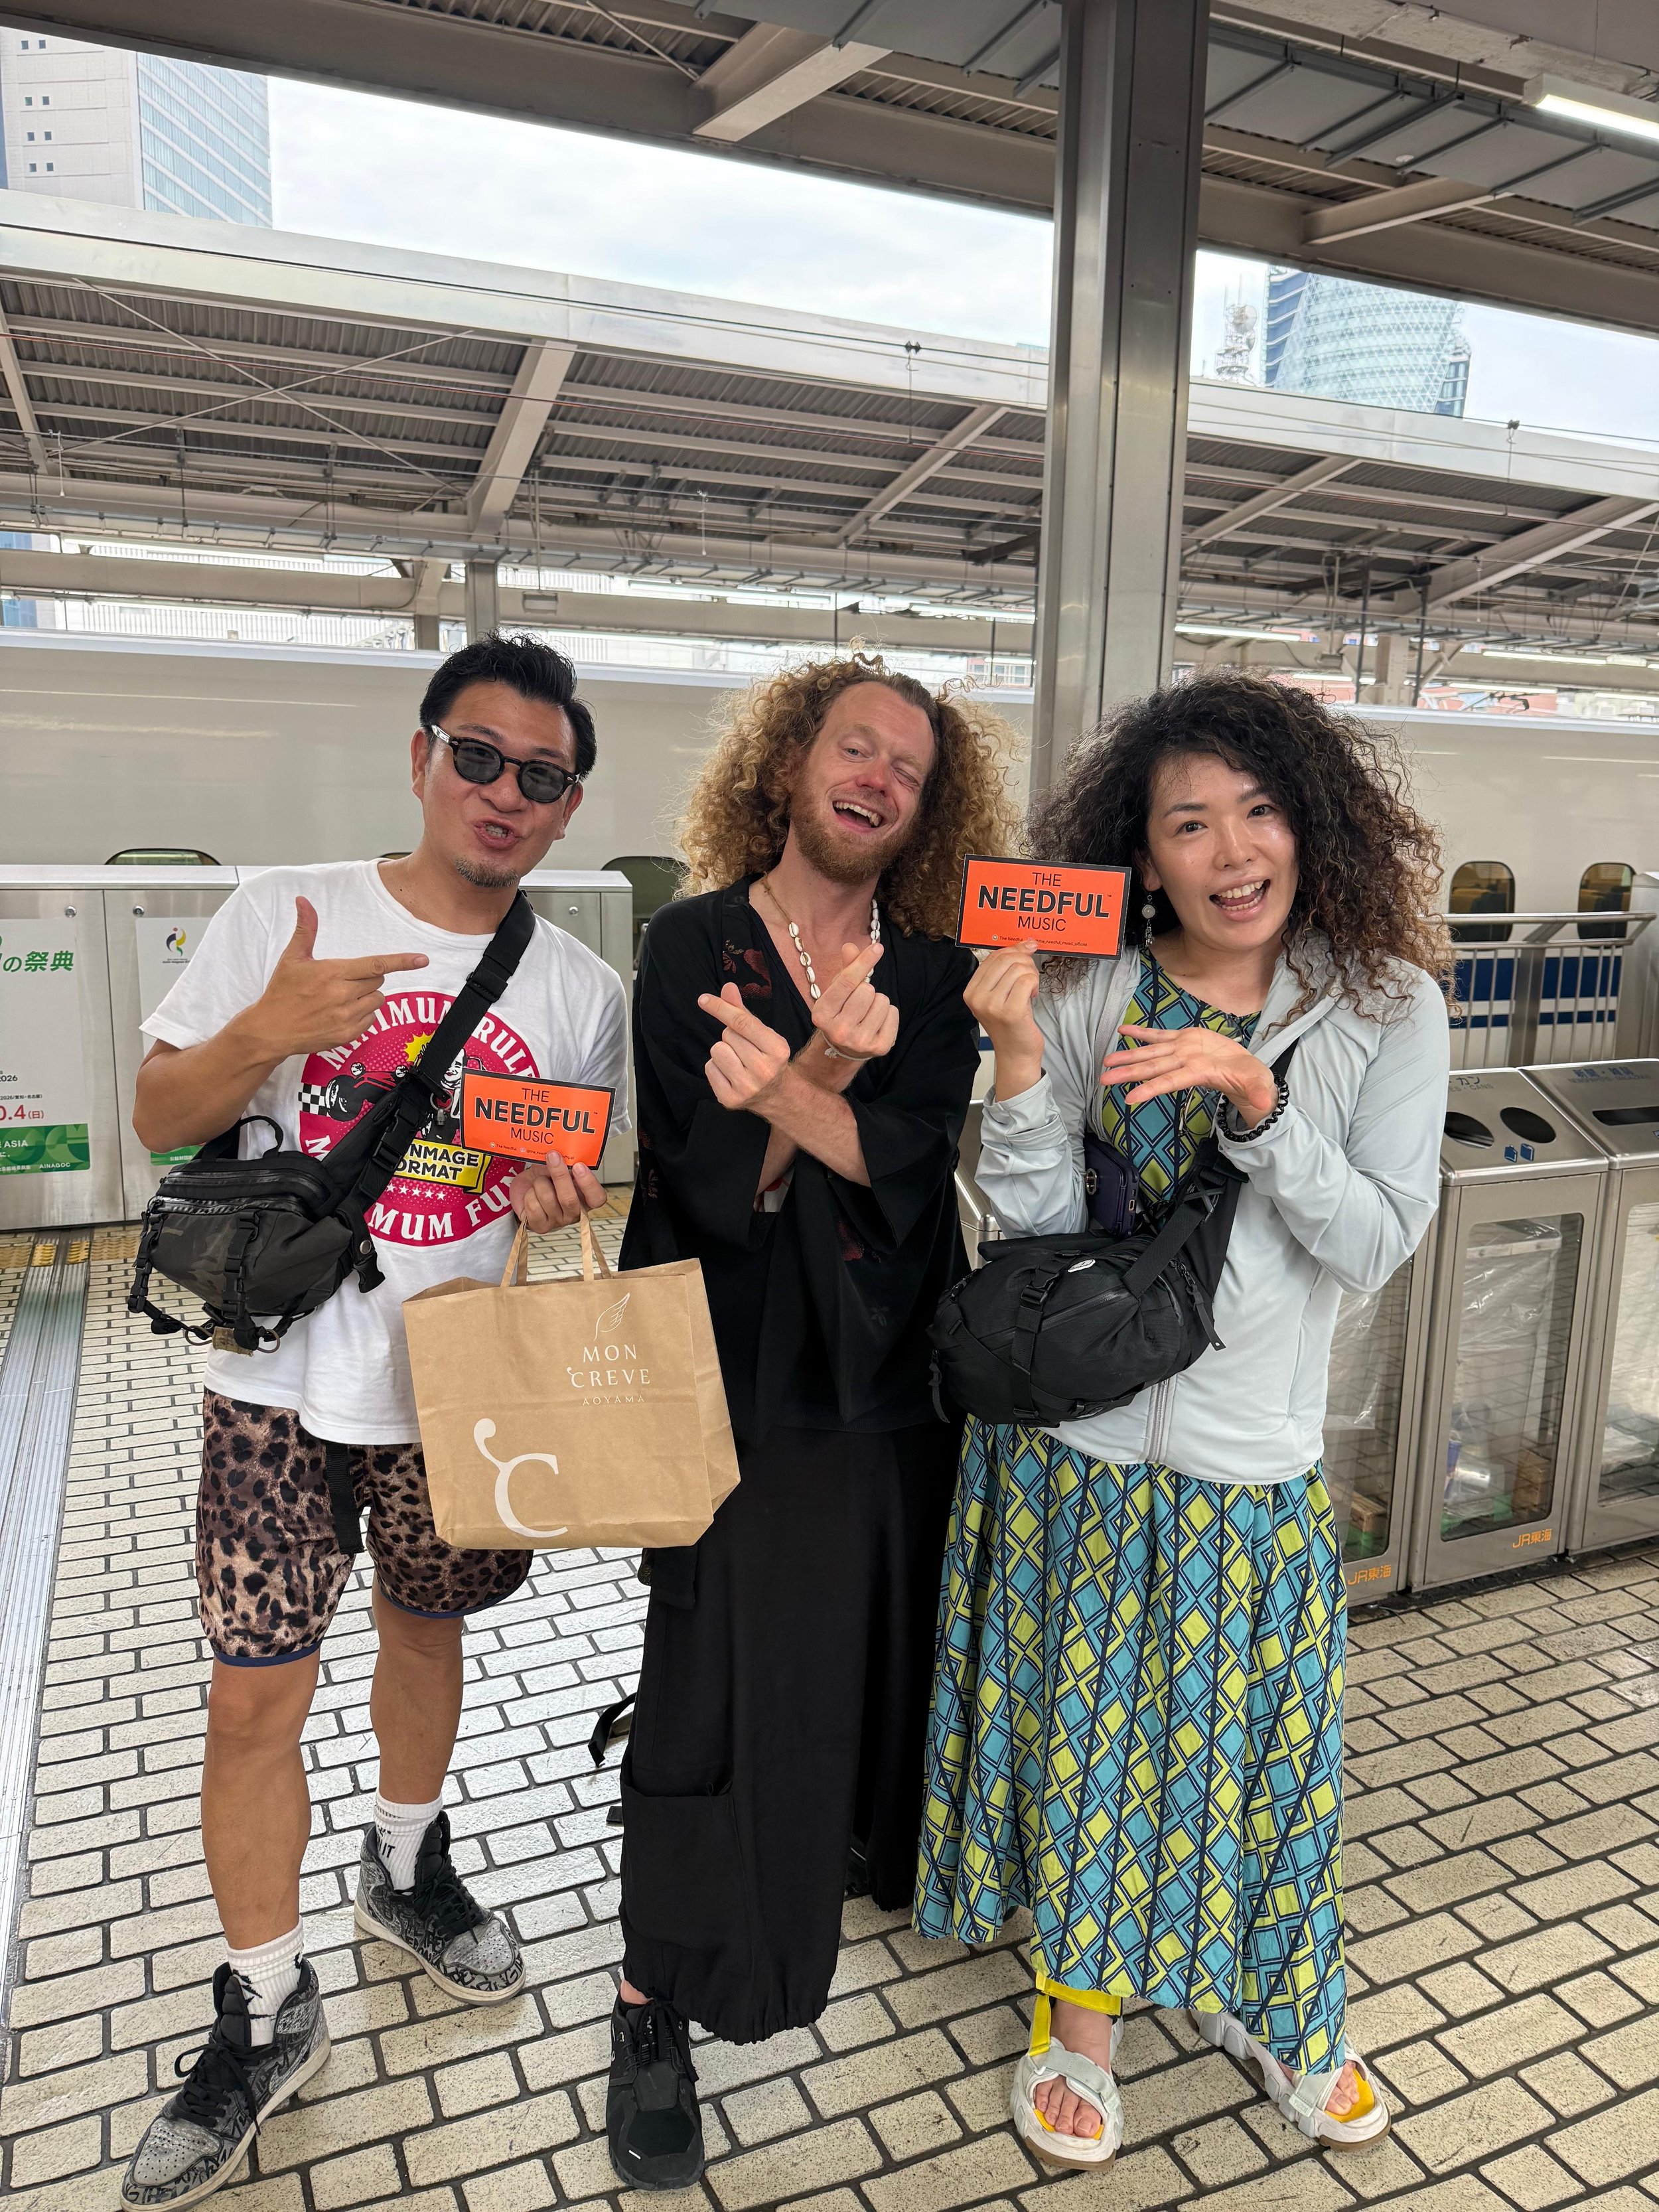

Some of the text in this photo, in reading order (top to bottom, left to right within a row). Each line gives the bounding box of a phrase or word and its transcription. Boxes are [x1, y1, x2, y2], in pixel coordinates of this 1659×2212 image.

[1032, 872, 1062, 887] THE
[978, 885, 1110, 918] NEEDFUL
[1017, 915, 1066, 931] MUSIC
[0, 950, 74, 972] の祭典
[522, 1088, 550, 1102] THE
[475, 1097, 595, 1134] NEEDFUL
[511, 1127, 554, 1144] MUSIC
[410, 1143, 479, 1166] NMAGE
[396, 1159, 463, 1180] ORMAT
[583, 1343, 637, 1364] MON
[566, 1366, 650, 1388] CREVE
[582, 1394, 645, 1406] AOYAMA
[1512, 1528, 1552, 1548] JR東海
[1348, 1564, 1392, 1585] JR東海
